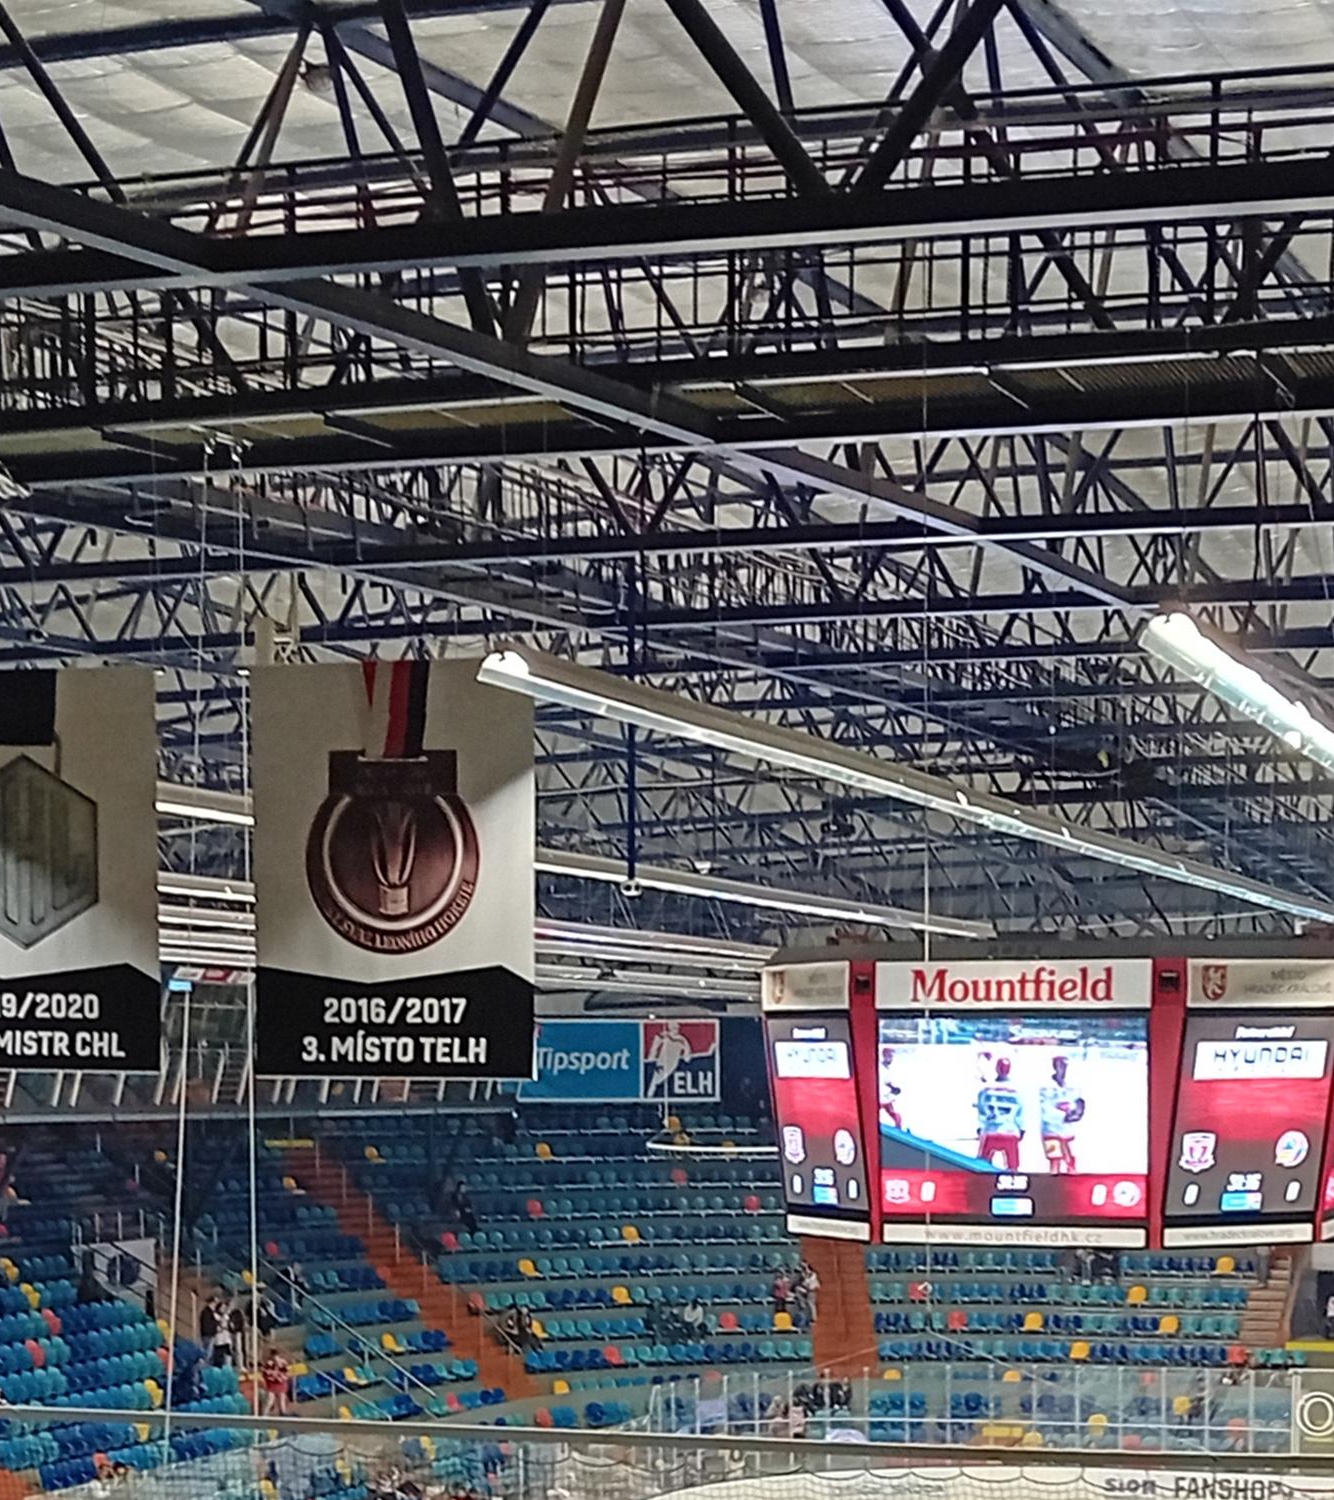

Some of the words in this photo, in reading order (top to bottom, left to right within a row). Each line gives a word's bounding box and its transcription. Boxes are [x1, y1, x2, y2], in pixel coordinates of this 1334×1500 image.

[910, 966, 1113, 1003] Mountfield
[323, 996, 467, 1024] 2016/2017
[75, 1030, 127, 1057] CHL
[301, 1034, 327, 1063] 3.
[330, 1029, 415, 1063] MÍSTO
[418, 1036, 488, 1064] TELH
[536, 1046, 631, 1076] Tipsport
[673, 1070, 713, 1095] ELH
